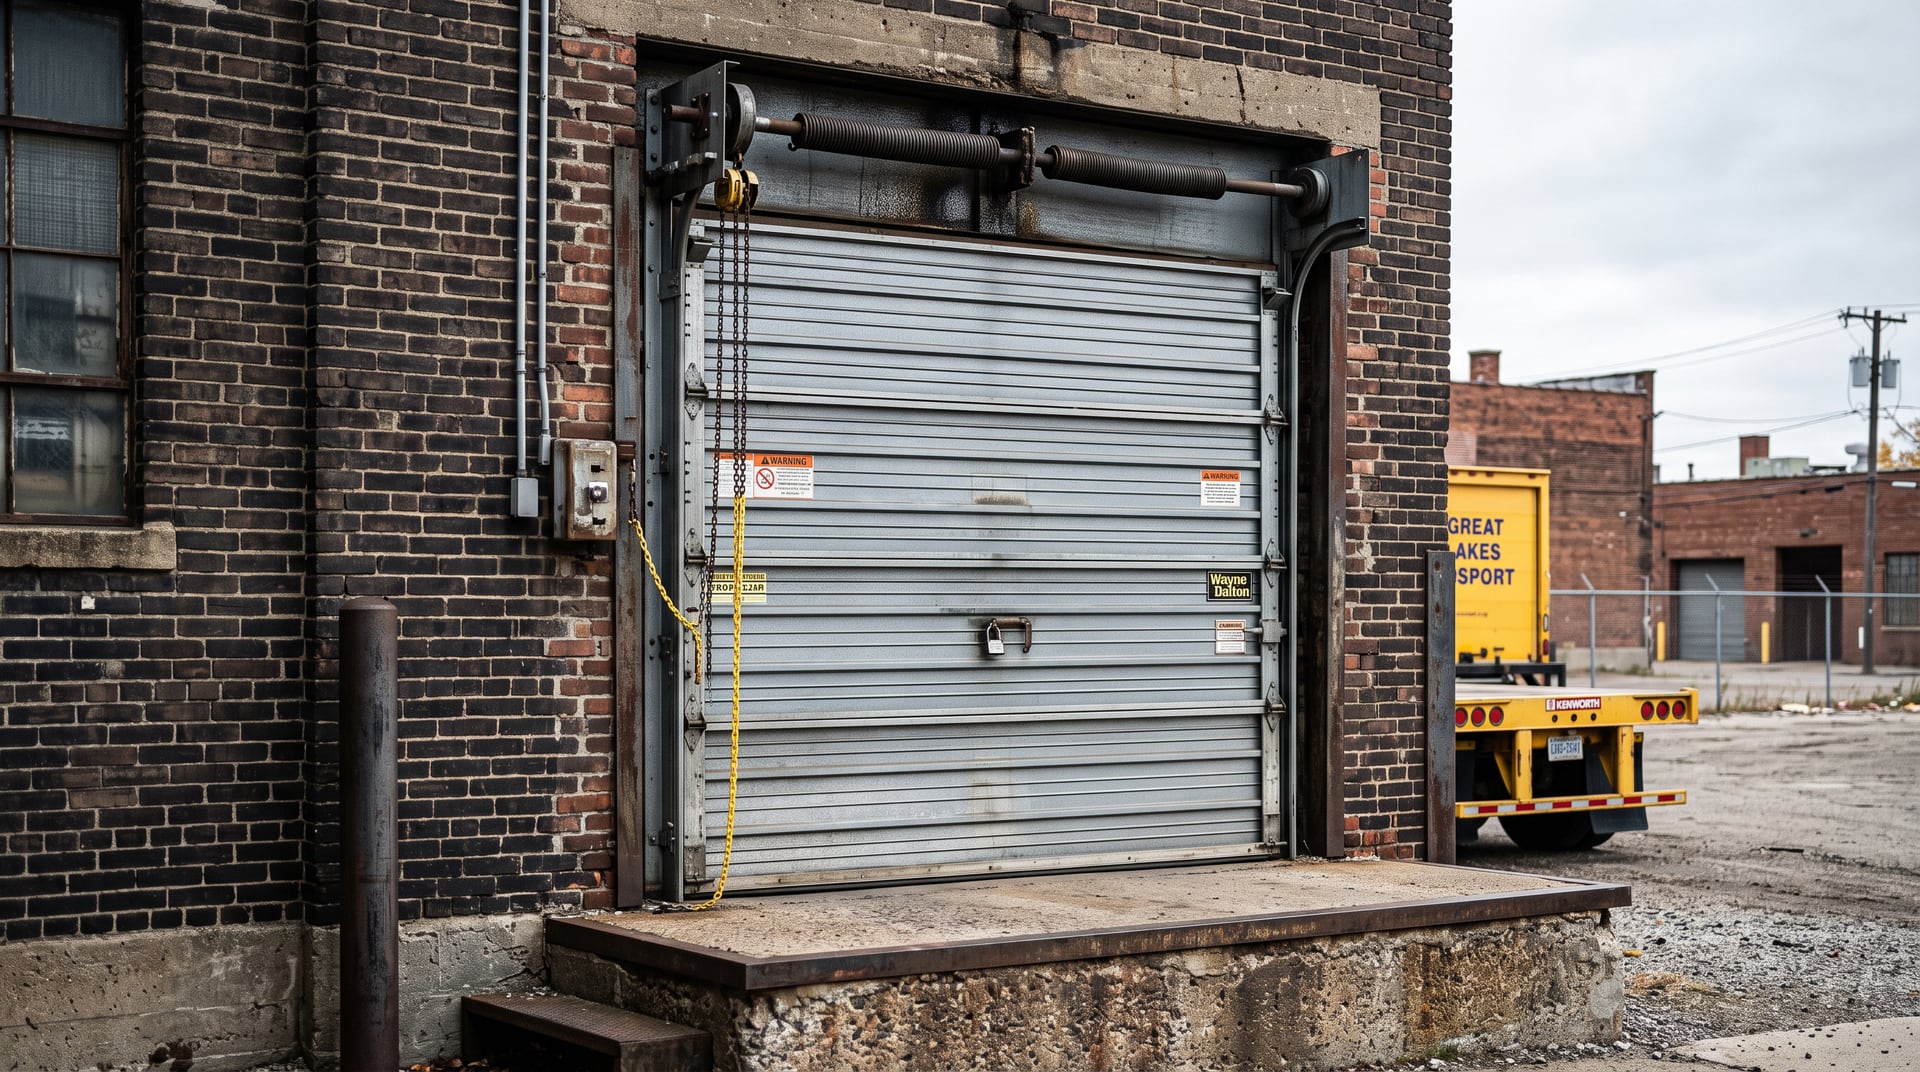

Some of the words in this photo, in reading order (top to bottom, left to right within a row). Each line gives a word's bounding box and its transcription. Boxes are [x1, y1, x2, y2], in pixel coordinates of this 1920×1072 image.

[770, 456, 807, 466] WARNING
[1447, 517, 1504, 535] GREAT
[1455, 542, 1501, 561] AKES
[1210, 573, 1248, 588] Wayne
[1455, 567, 1515, 586] SPORT
[1214, 585, 1250, 598] Dalton
[1556, 698, 1601, 710] KENWORTH
